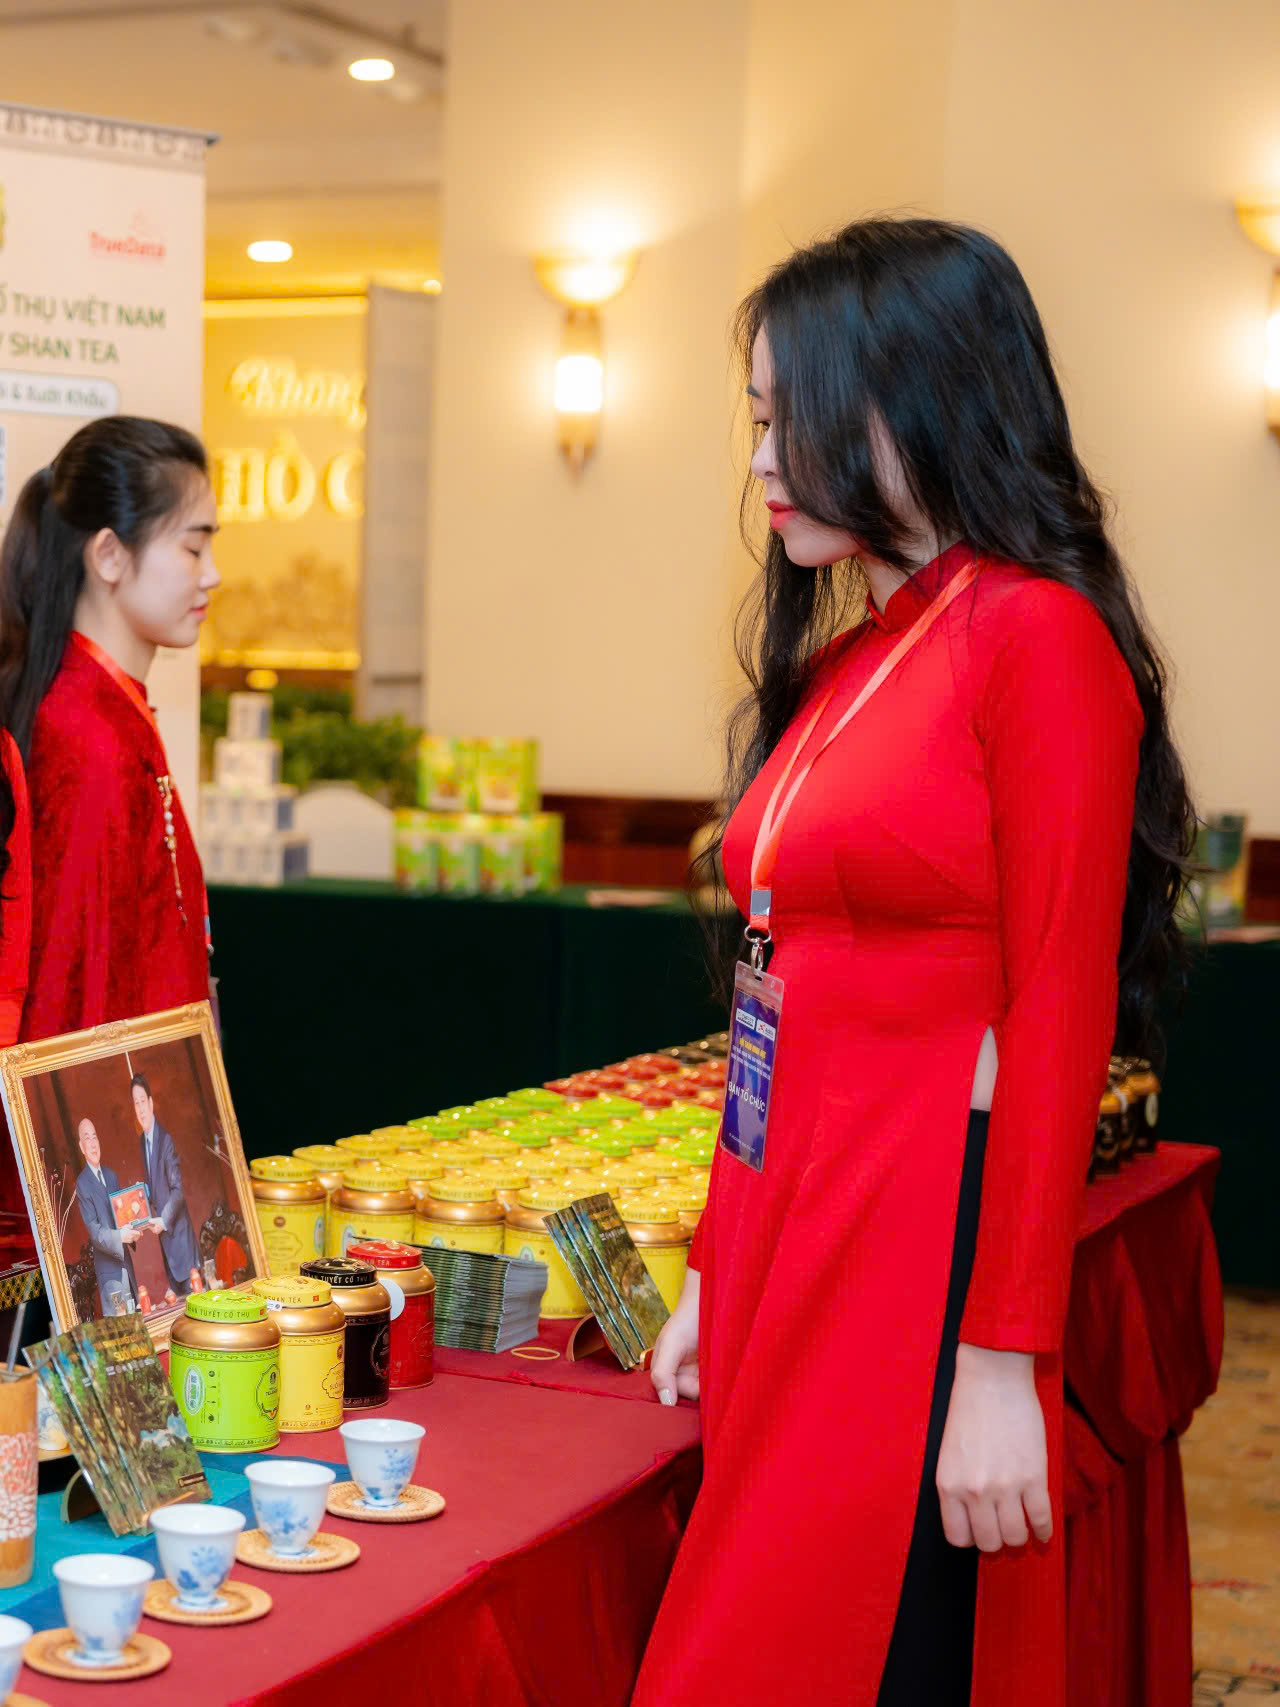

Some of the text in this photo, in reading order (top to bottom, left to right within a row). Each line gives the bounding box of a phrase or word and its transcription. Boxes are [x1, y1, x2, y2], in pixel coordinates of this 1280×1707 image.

[62, 294, 112, 328] VIỆT
[116, 304, 167, 330] NAM
[9, 331, 73, 359] SHAN
[78, 337, 119, 363] TEA
[728, 1080, 741, 1097] BAN
